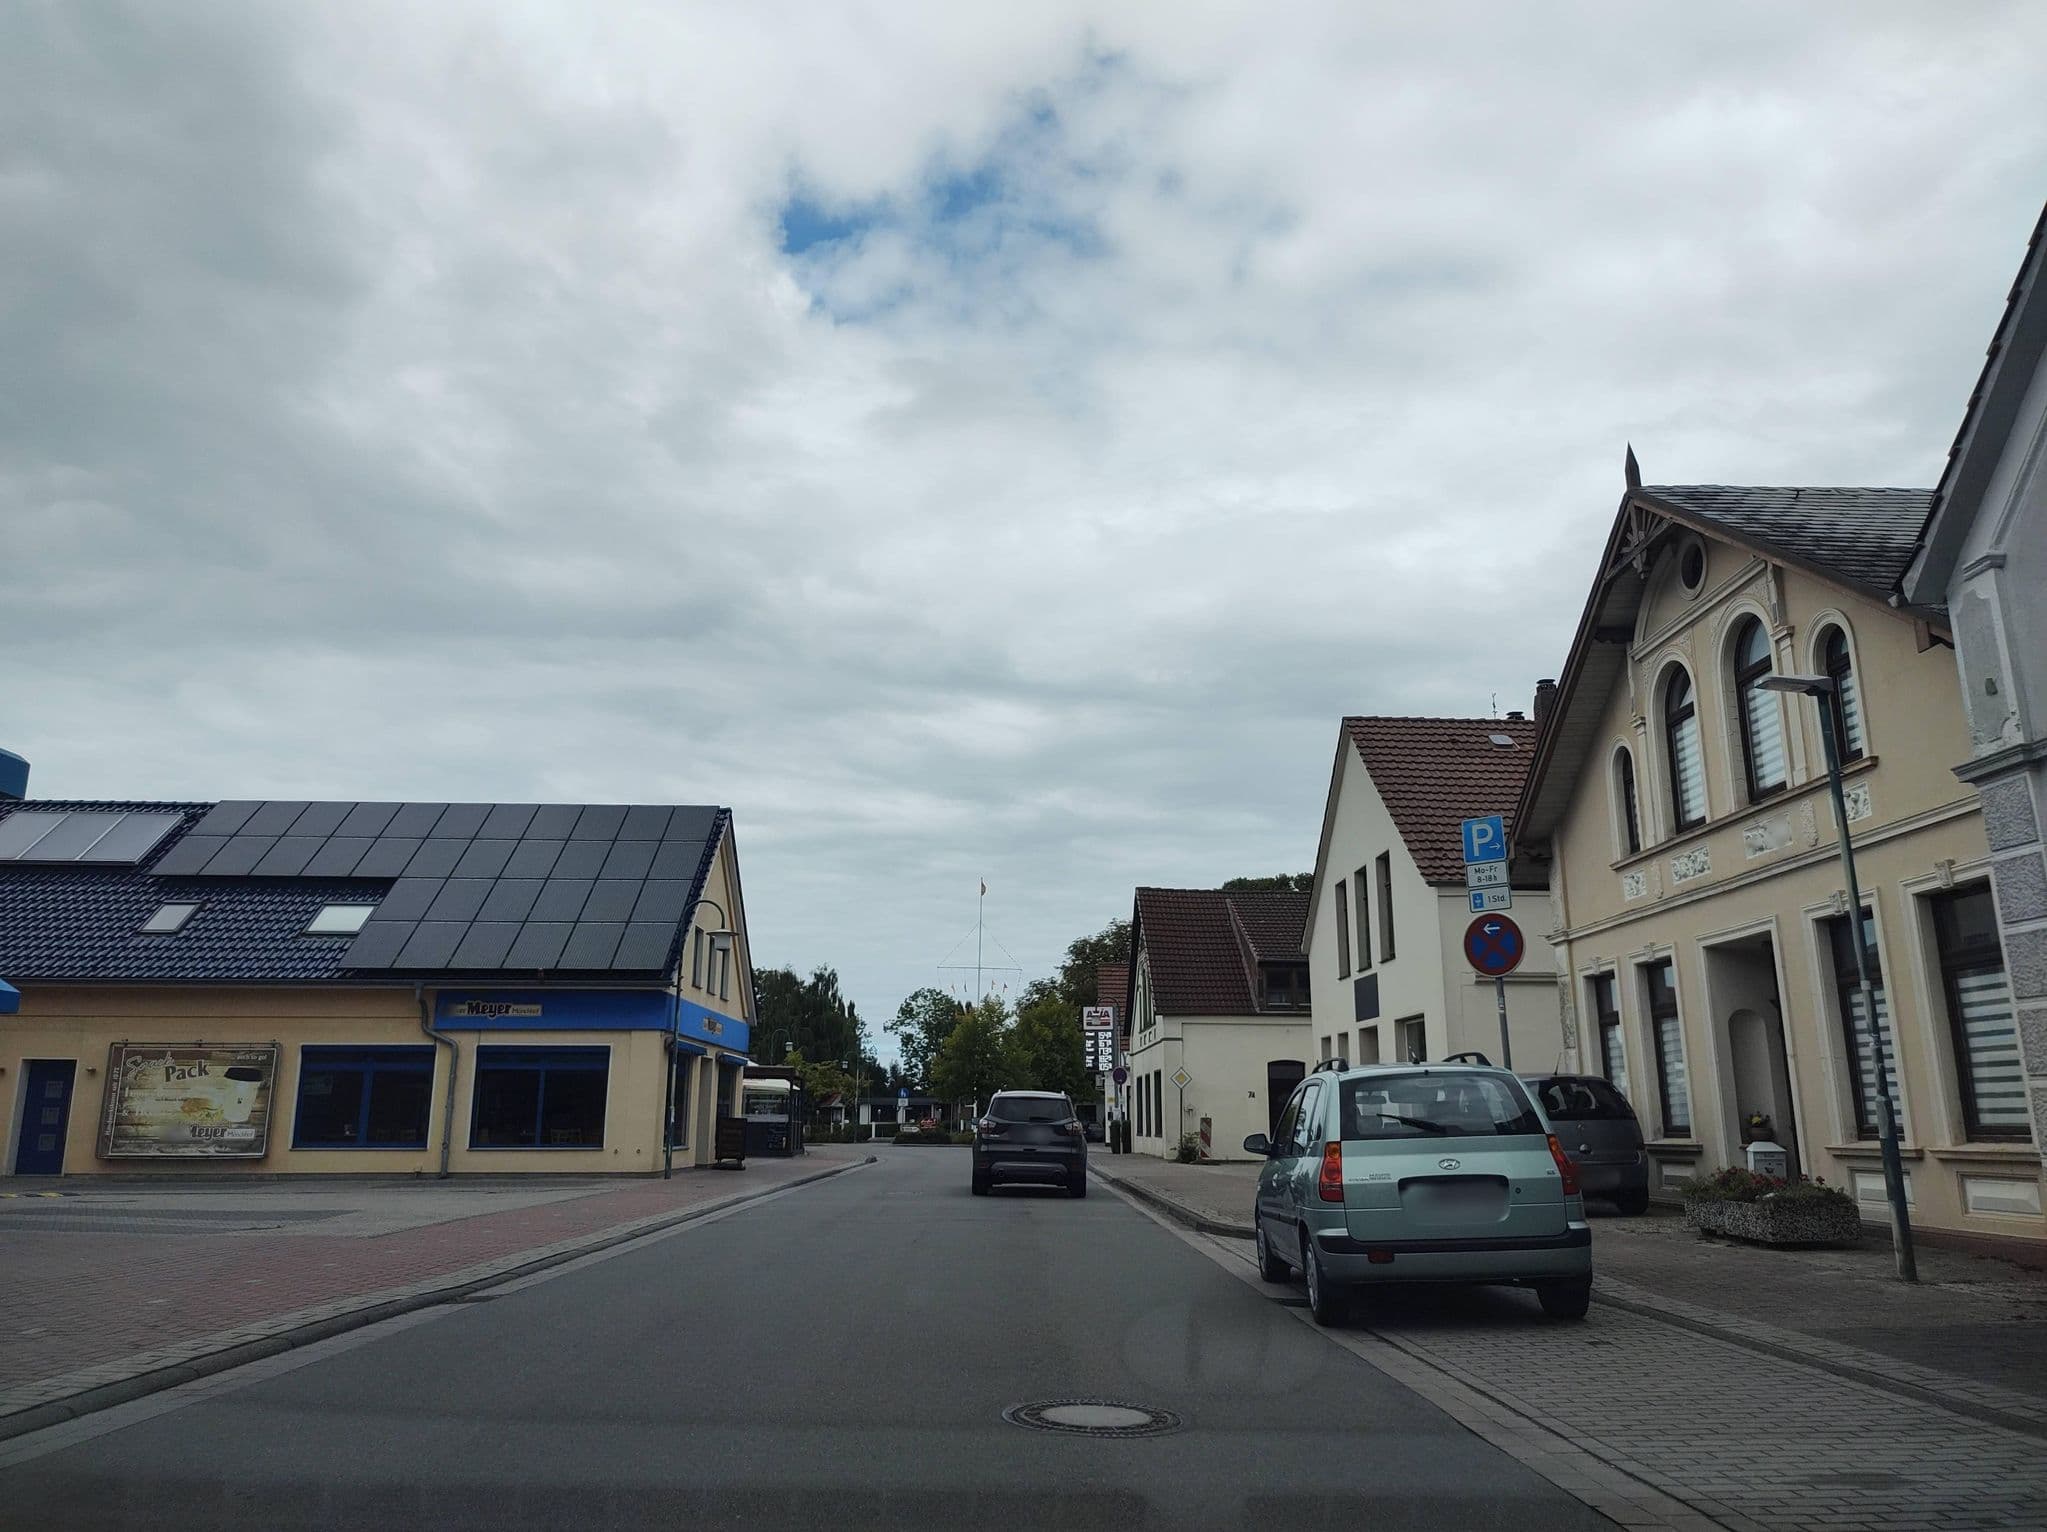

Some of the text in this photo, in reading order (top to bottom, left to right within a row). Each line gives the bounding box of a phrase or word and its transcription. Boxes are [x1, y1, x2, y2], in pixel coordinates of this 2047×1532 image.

[1472, 824, 1493, 856] P
[1474, 865, 1498, 874] Mo-Fr
[466, 1000, 512, 1018] Meyer
[165, 1059, 210, 1082] Pack
